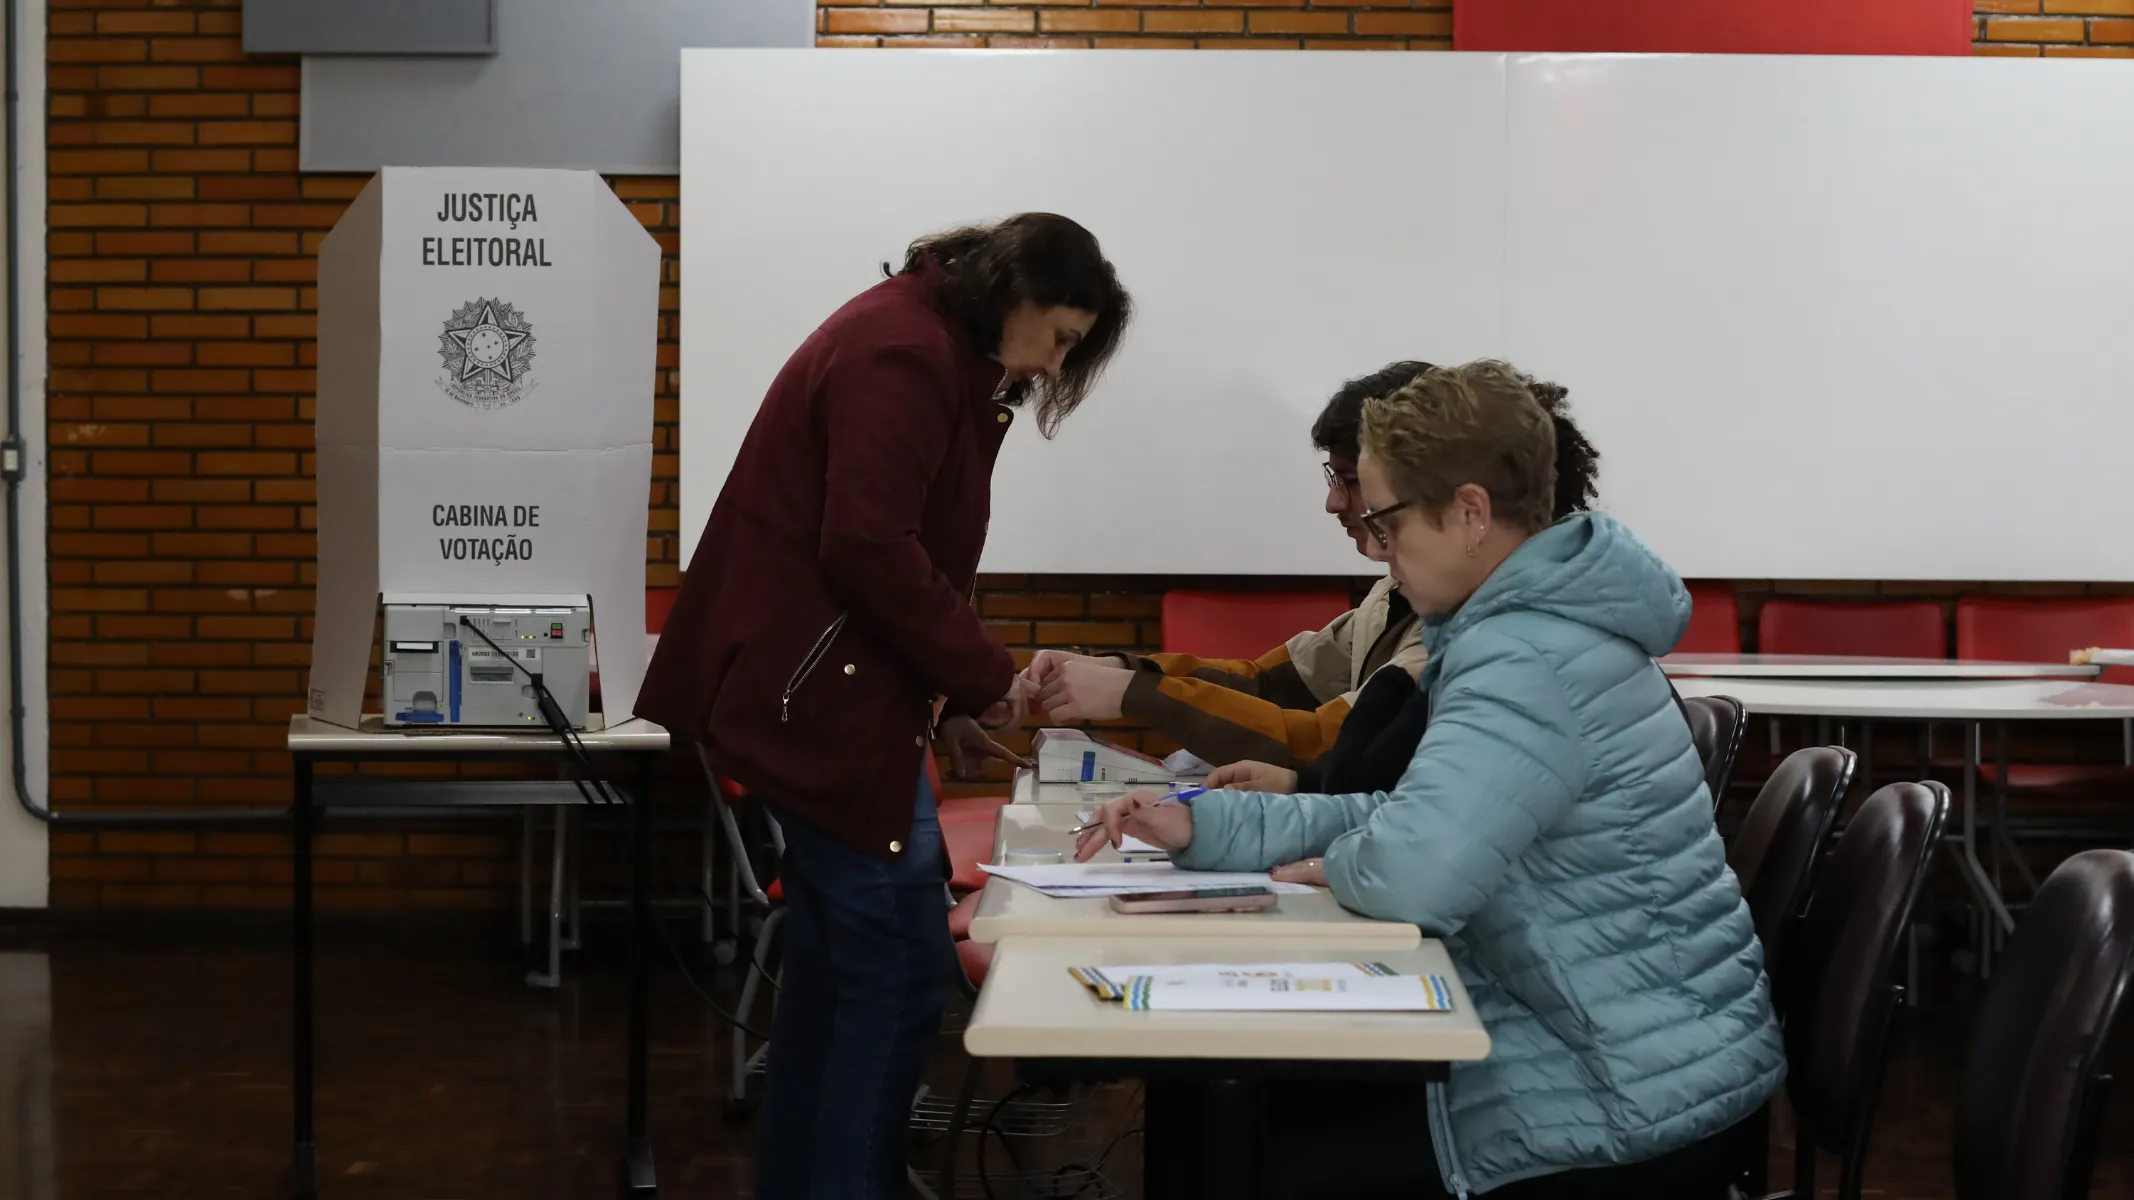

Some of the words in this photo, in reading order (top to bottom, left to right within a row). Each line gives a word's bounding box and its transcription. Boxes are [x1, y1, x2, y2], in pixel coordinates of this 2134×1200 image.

[437, 193, 538, 231] JUSTIÇA
[422, 237, 552, 267] ELEITORAL
[432, 504, 508, 528] CABINA
[513, 504, 540, 528] DE
[439, 533, 533, 567] VOTAÇÃO
